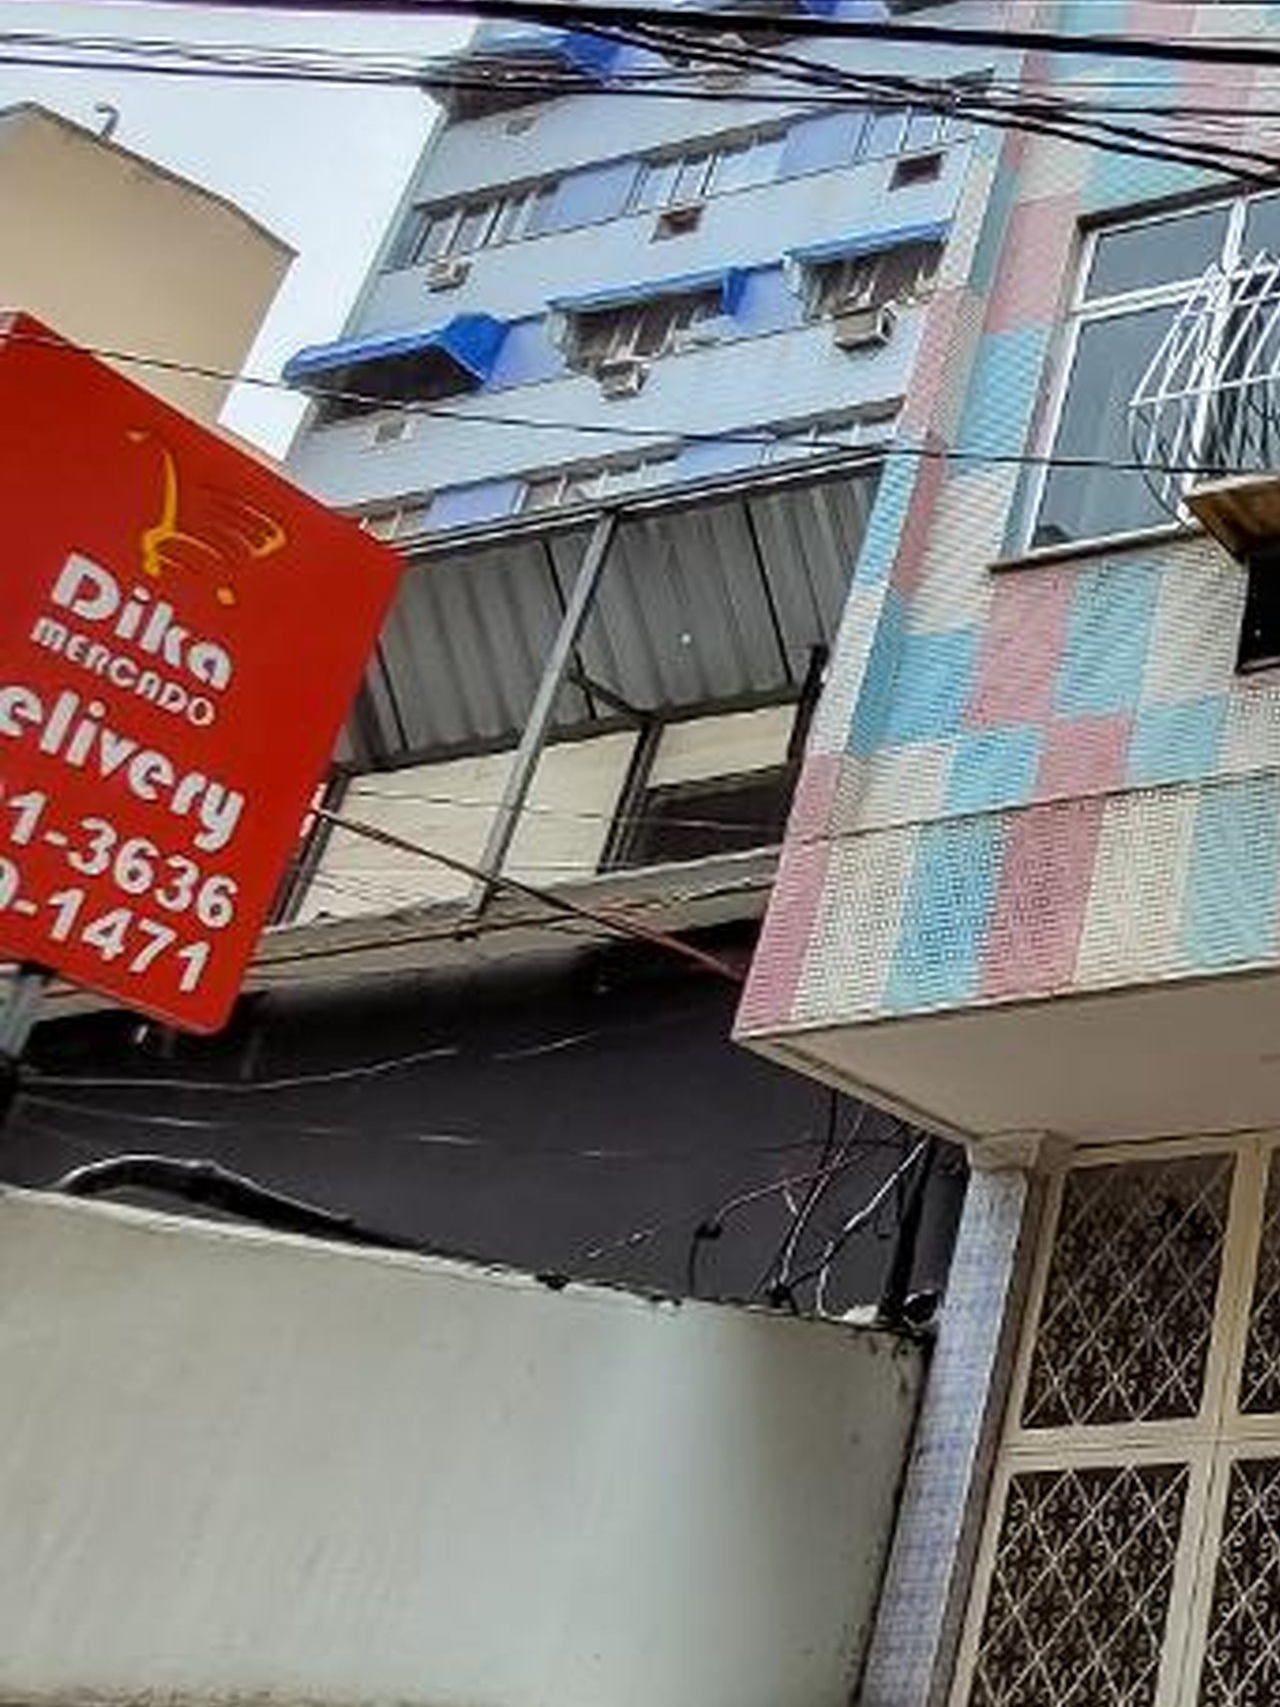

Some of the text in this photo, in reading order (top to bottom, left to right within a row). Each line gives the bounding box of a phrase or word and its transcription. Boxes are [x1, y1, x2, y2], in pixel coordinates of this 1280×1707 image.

[30, 616, 216, 727] MERCADO
[50, 552, 234, 692] Dika
[0, 685, 245, 853] elivery
[0, 784, 239, 929] 1-3636
